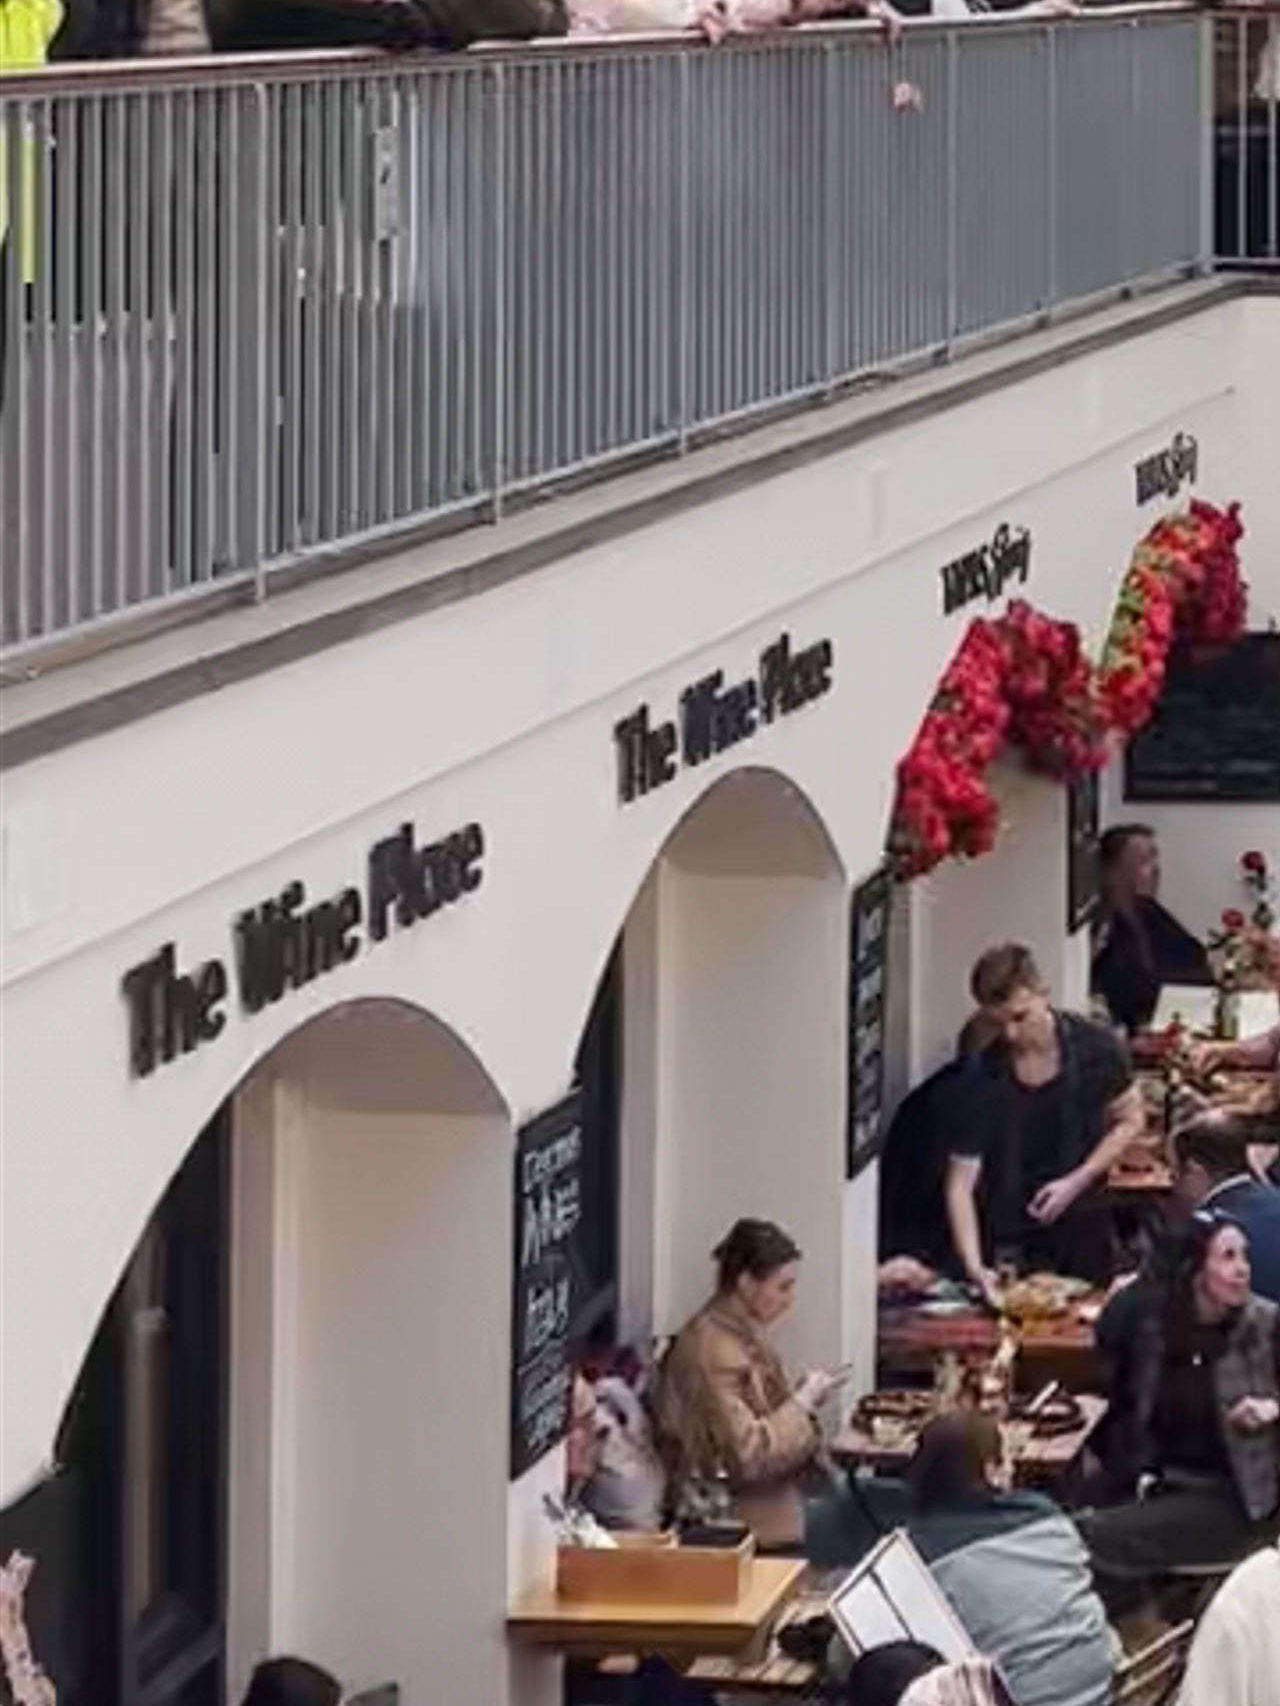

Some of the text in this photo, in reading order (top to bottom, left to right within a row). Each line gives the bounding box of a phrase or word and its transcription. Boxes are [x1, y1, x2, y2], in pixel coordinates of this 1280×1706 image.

[611, 632, 832, 803] The Wine Place
[121, 821, 484, 1080] The Wine Place
